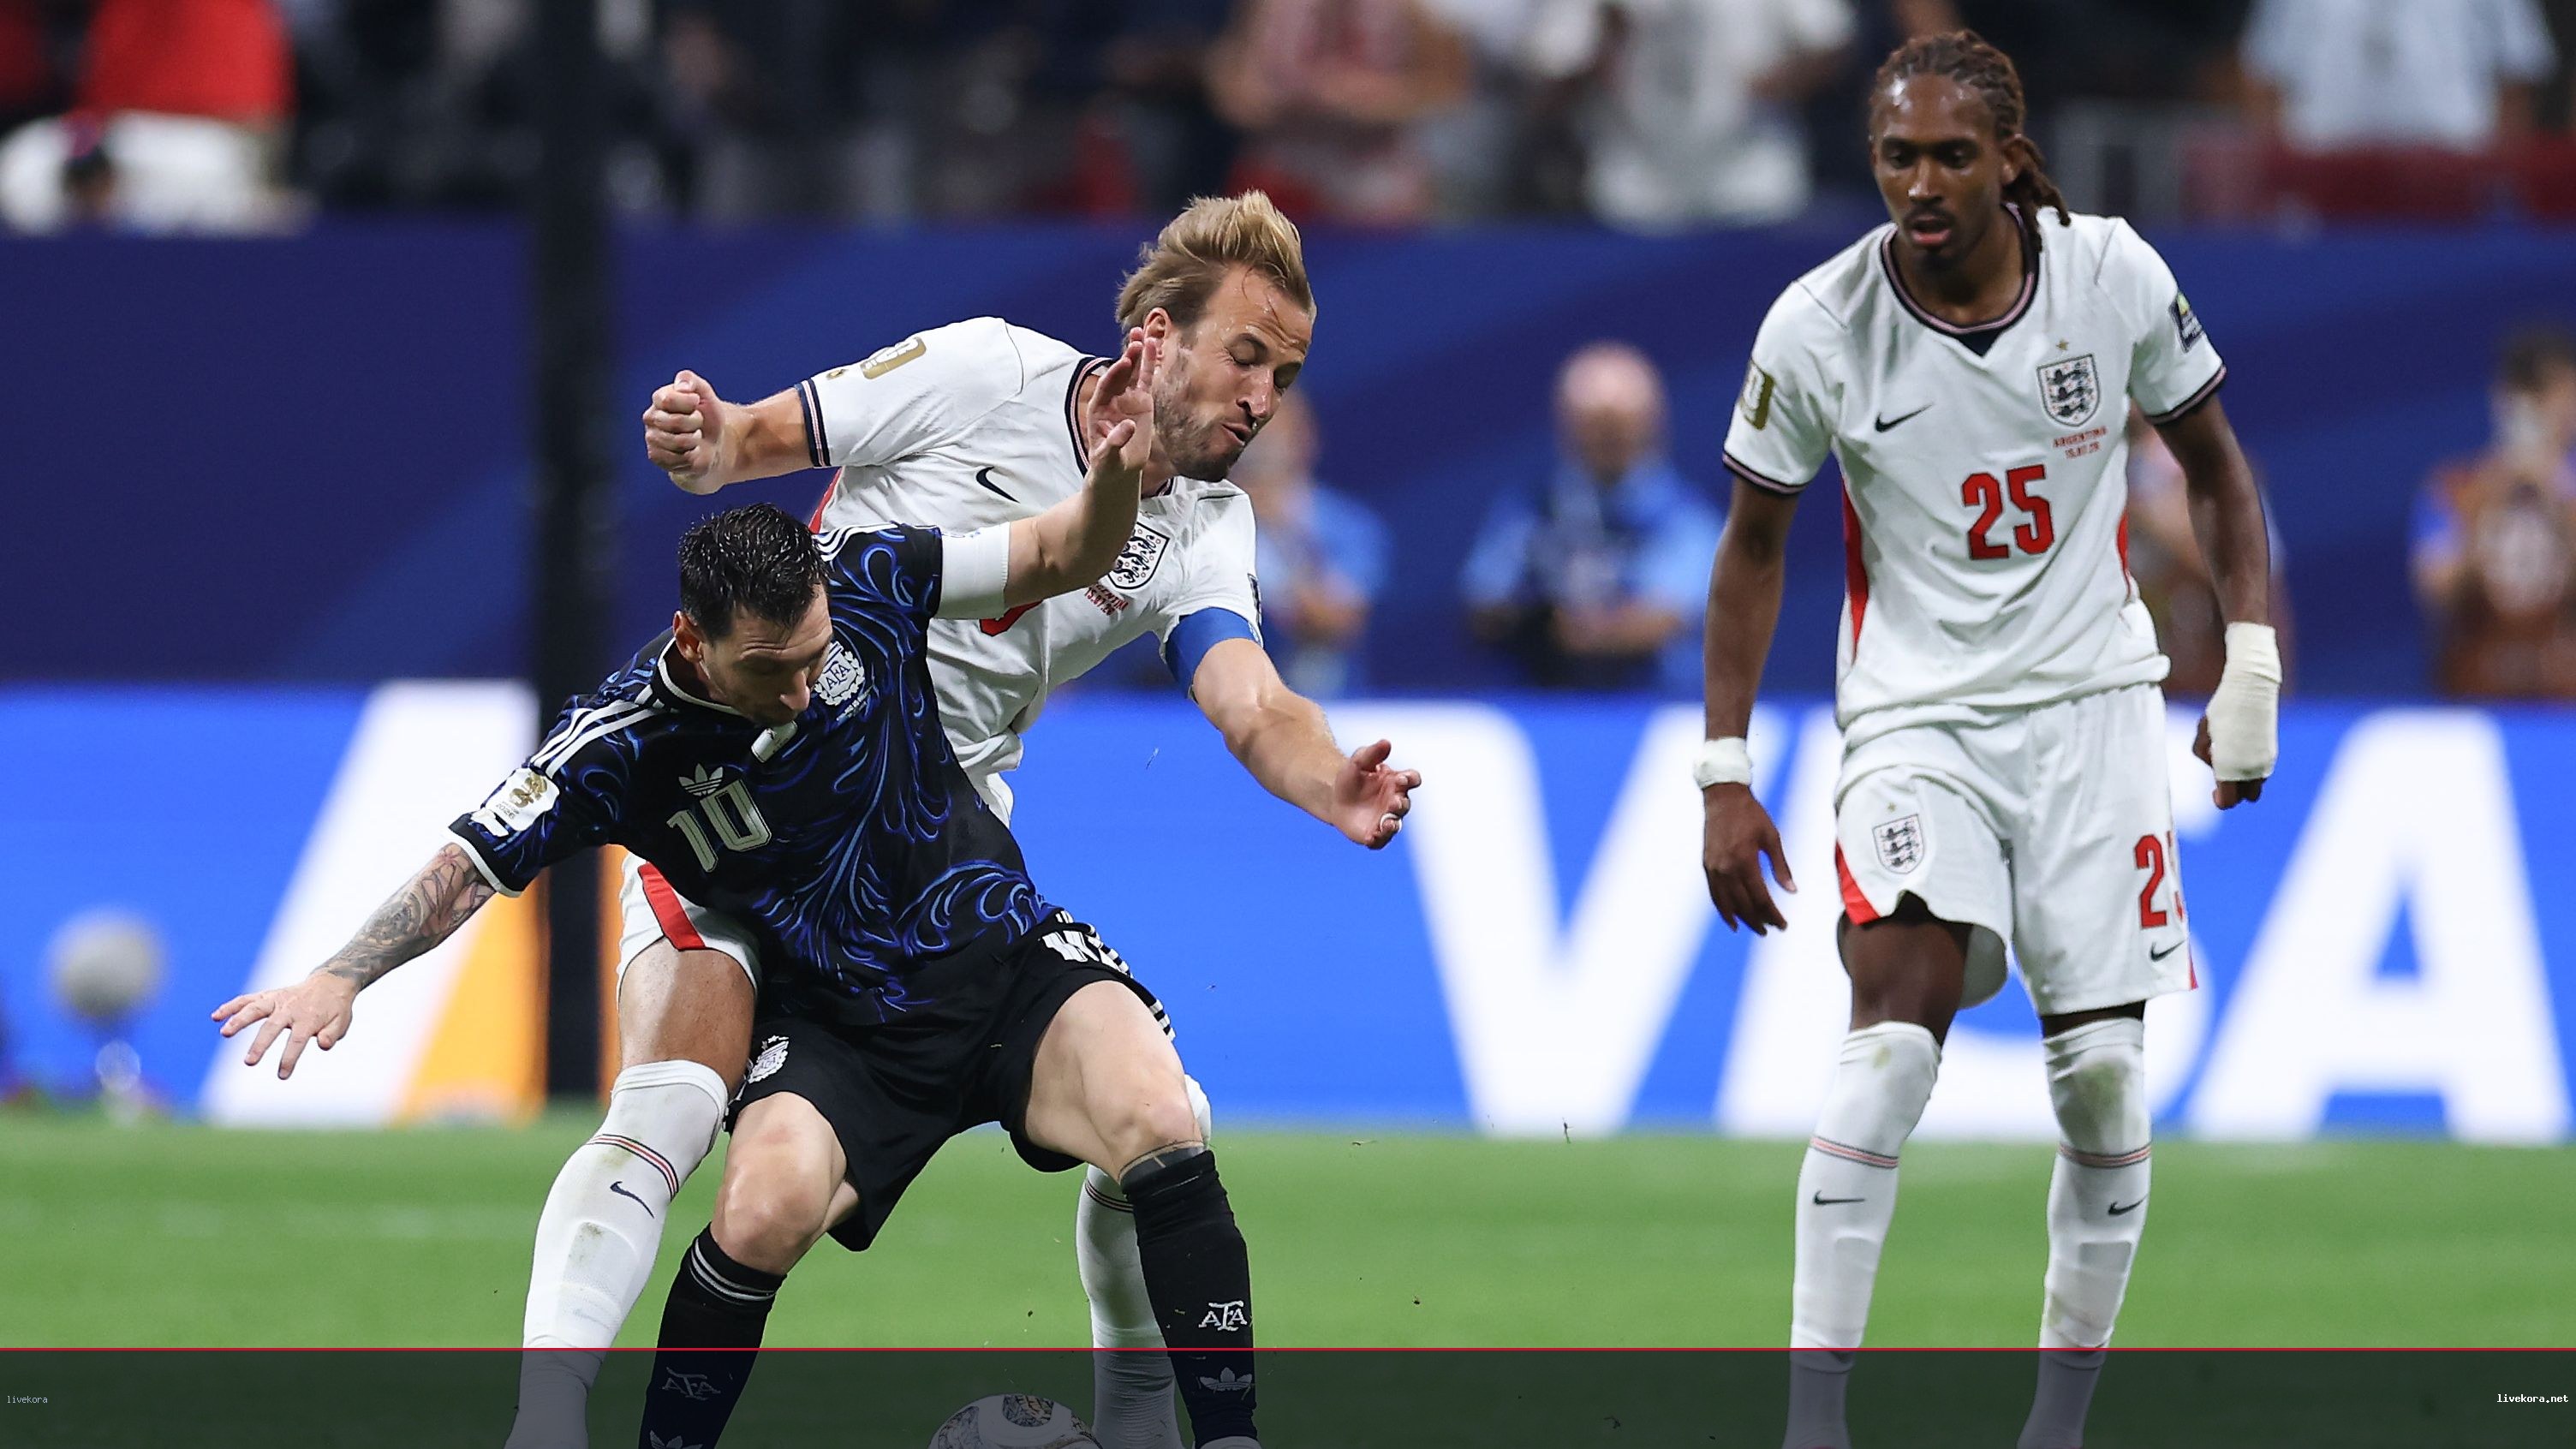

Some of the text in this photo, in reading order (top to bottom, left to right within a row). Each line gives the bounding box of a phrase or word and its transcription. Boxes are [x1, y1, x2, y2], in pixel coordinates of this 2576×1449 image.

[1961, 463, 2055, 561] 25
[665, 778, 772, 873] 10
[1198, 1300, 1249, 1332] AFA
[661, 1366, 722, 1401] AFA
